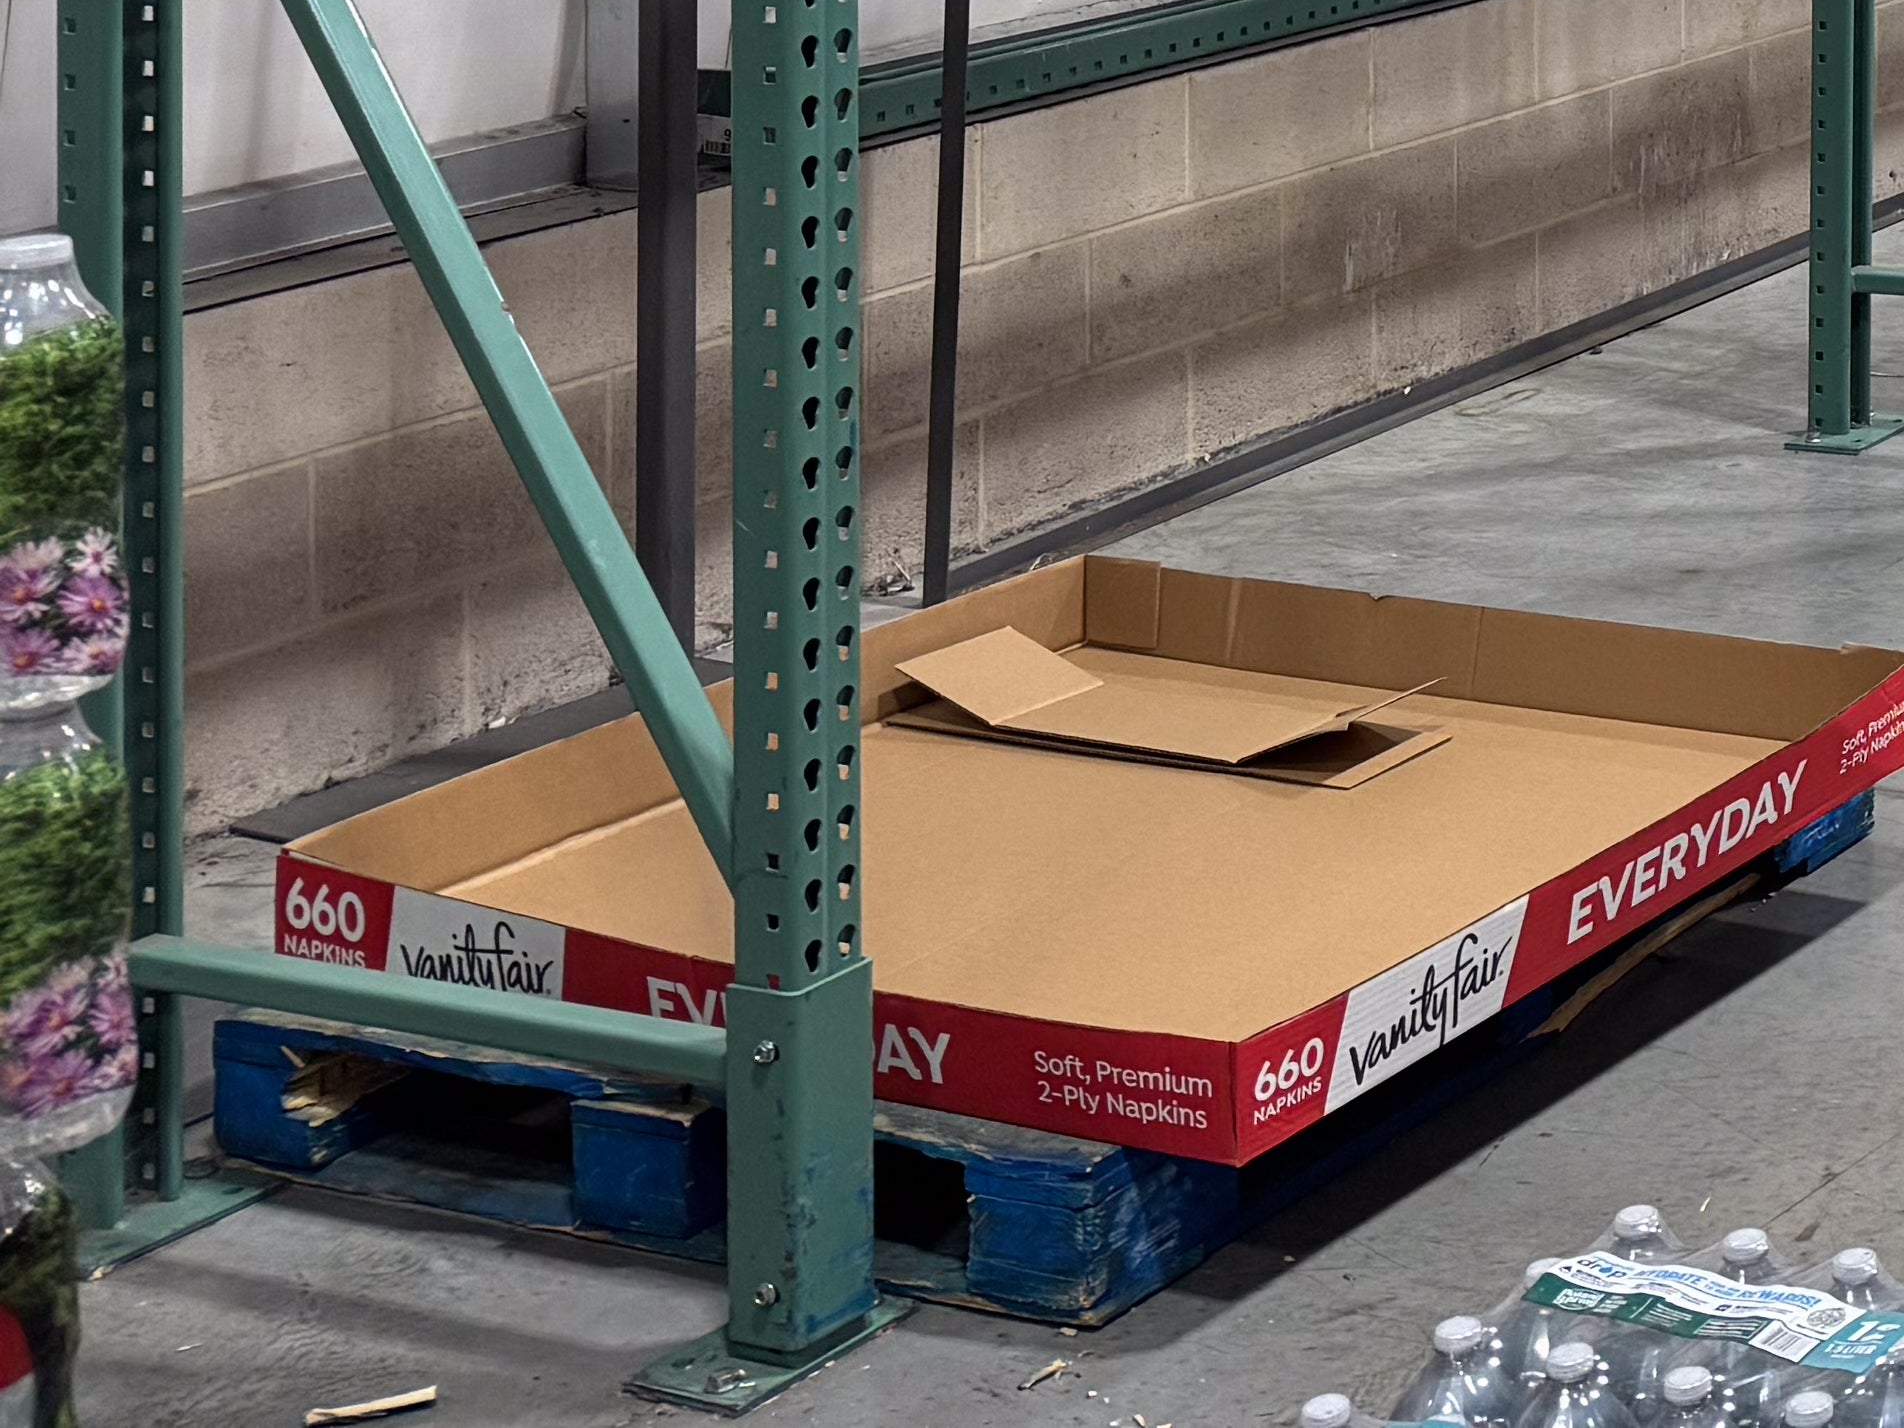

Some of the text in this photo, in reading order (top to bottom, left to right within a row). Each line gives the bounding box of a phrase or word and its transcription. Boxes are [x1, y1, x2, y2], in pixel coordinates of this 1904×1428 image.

[1839, 747, 1870, 774] 2-Ply
[1841, 729, 1867, 754] Soft,
[1566, 759, 1807, 945] EVERYDAY
[286, 878, 365, 942] 660
[284, 933, 366, 969] NAPKINS
[1034, 1050, 1214, 1098] Soft, Premium
[1254, 1036, 1326, 1102] 660
[1037, 1081, 1208, 1129] 2-Ply Napkins
[1252, 1075, 1323, 1125] NAPKINS
[1577, 1259, 1627, 1278] drop
[1633, 1268, 1707, 1287] HYDRATE
